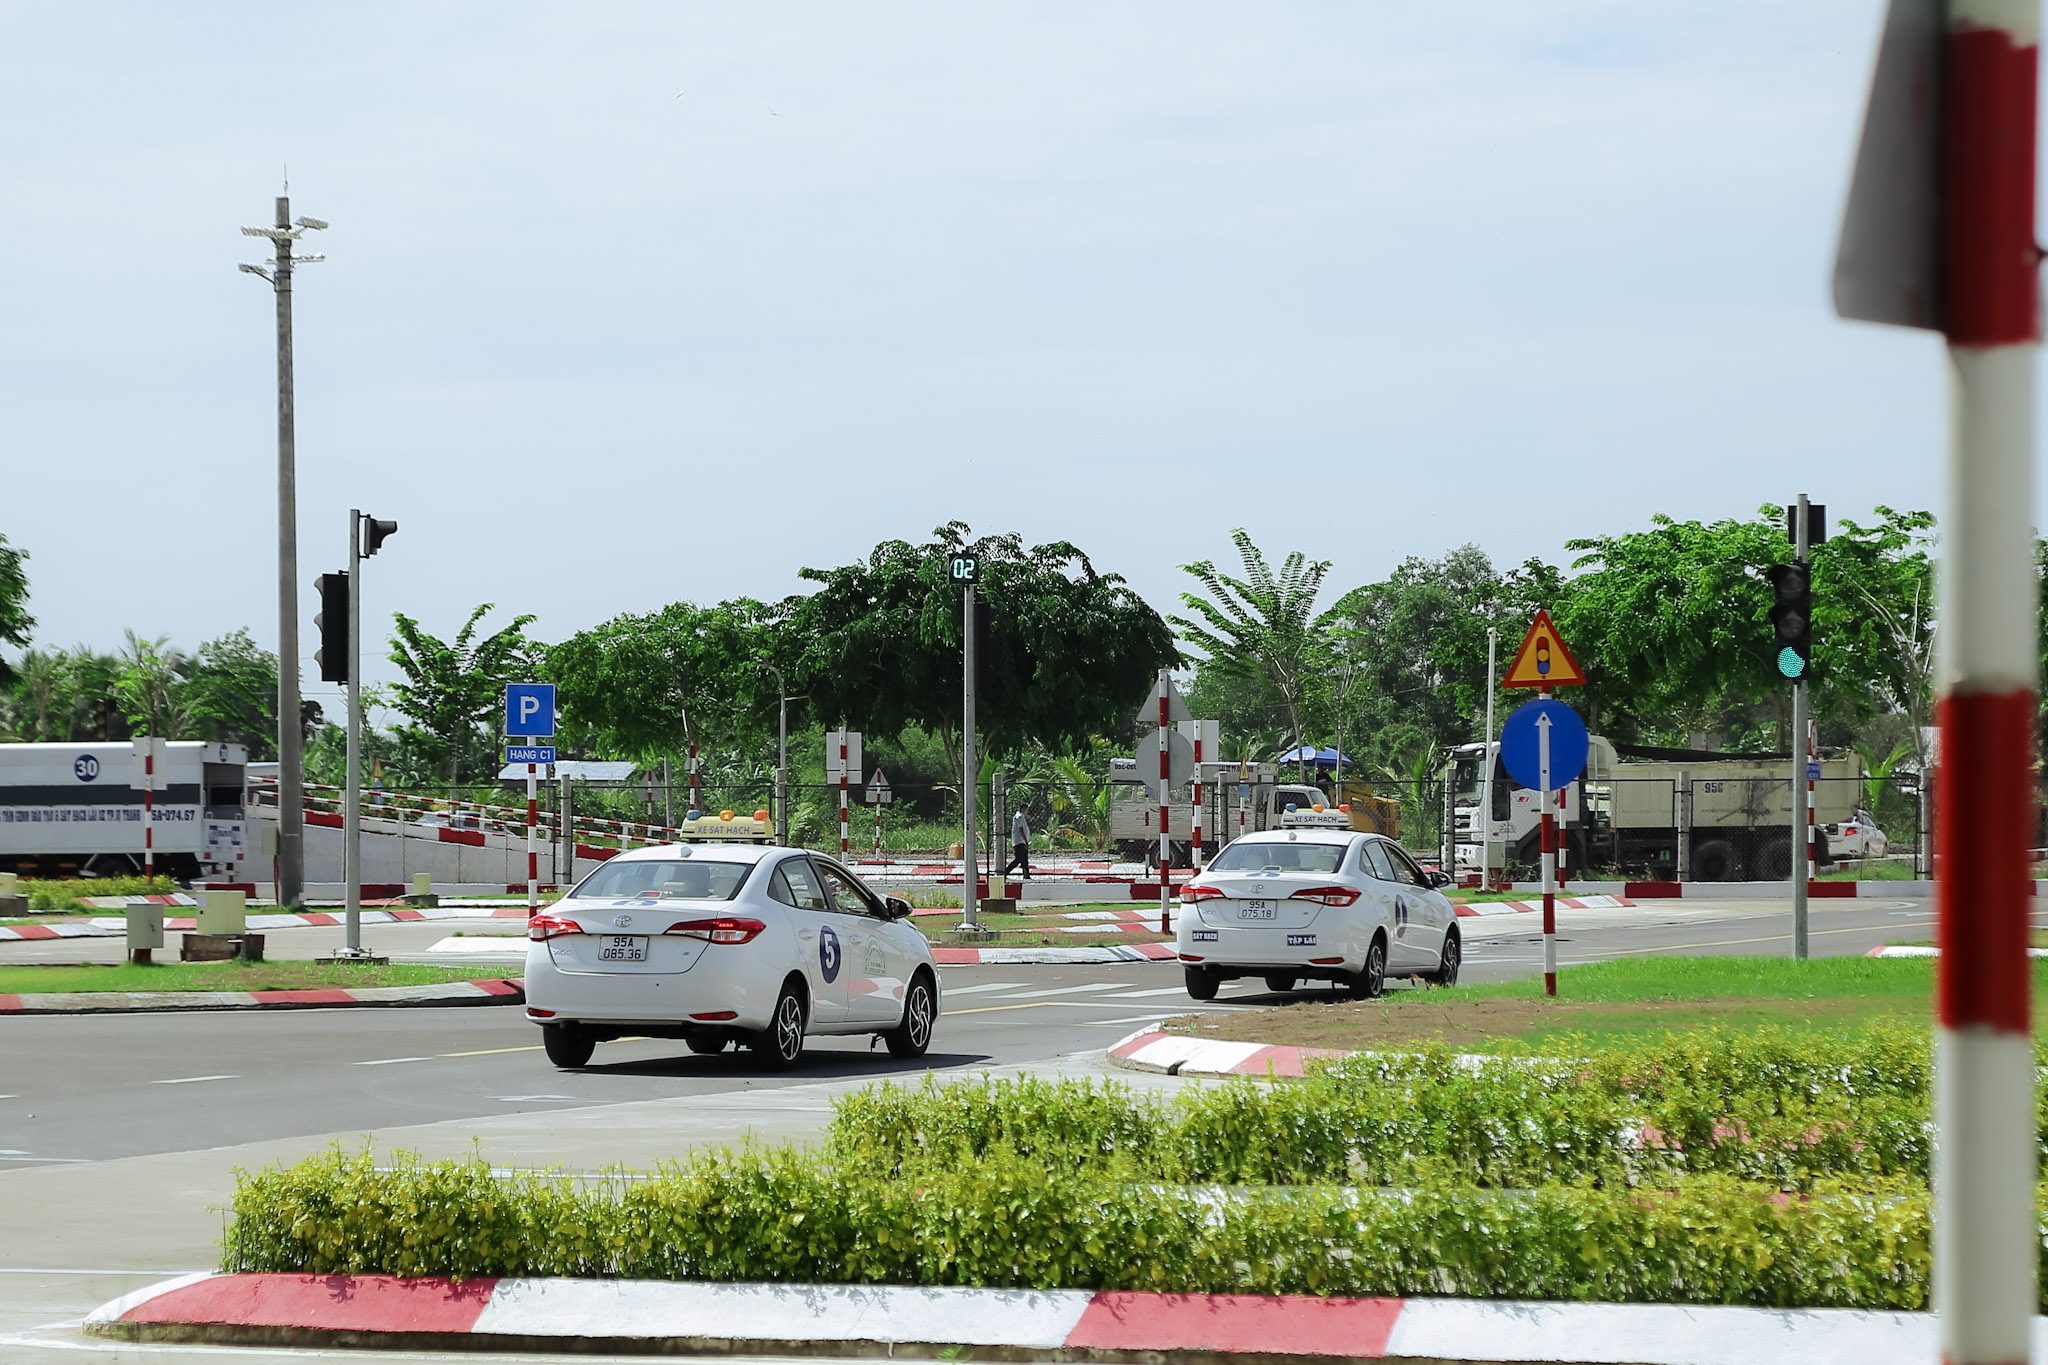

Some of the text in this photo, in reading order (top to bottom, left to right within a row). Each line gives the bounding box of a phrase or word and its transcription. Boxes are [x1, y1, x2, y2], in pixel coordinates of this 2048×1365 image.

[953, 559, 975, 579] 02
[520, 696, 540, 725] P
[510, 749, 551, 761] HẠNG C1
[76, 760, 97, 776] 30
[150, 809, 195, 821] 5A-074.67
[697, 825, 707, 834] XE
[1249, 900, 1265, 909] 95A
[1241, 909, 1272, 918] 075.18
[613, 937, 634, 948] 95A
[603, 948, 641, 960] 085.36
[823, 933, 835, 969] 5
